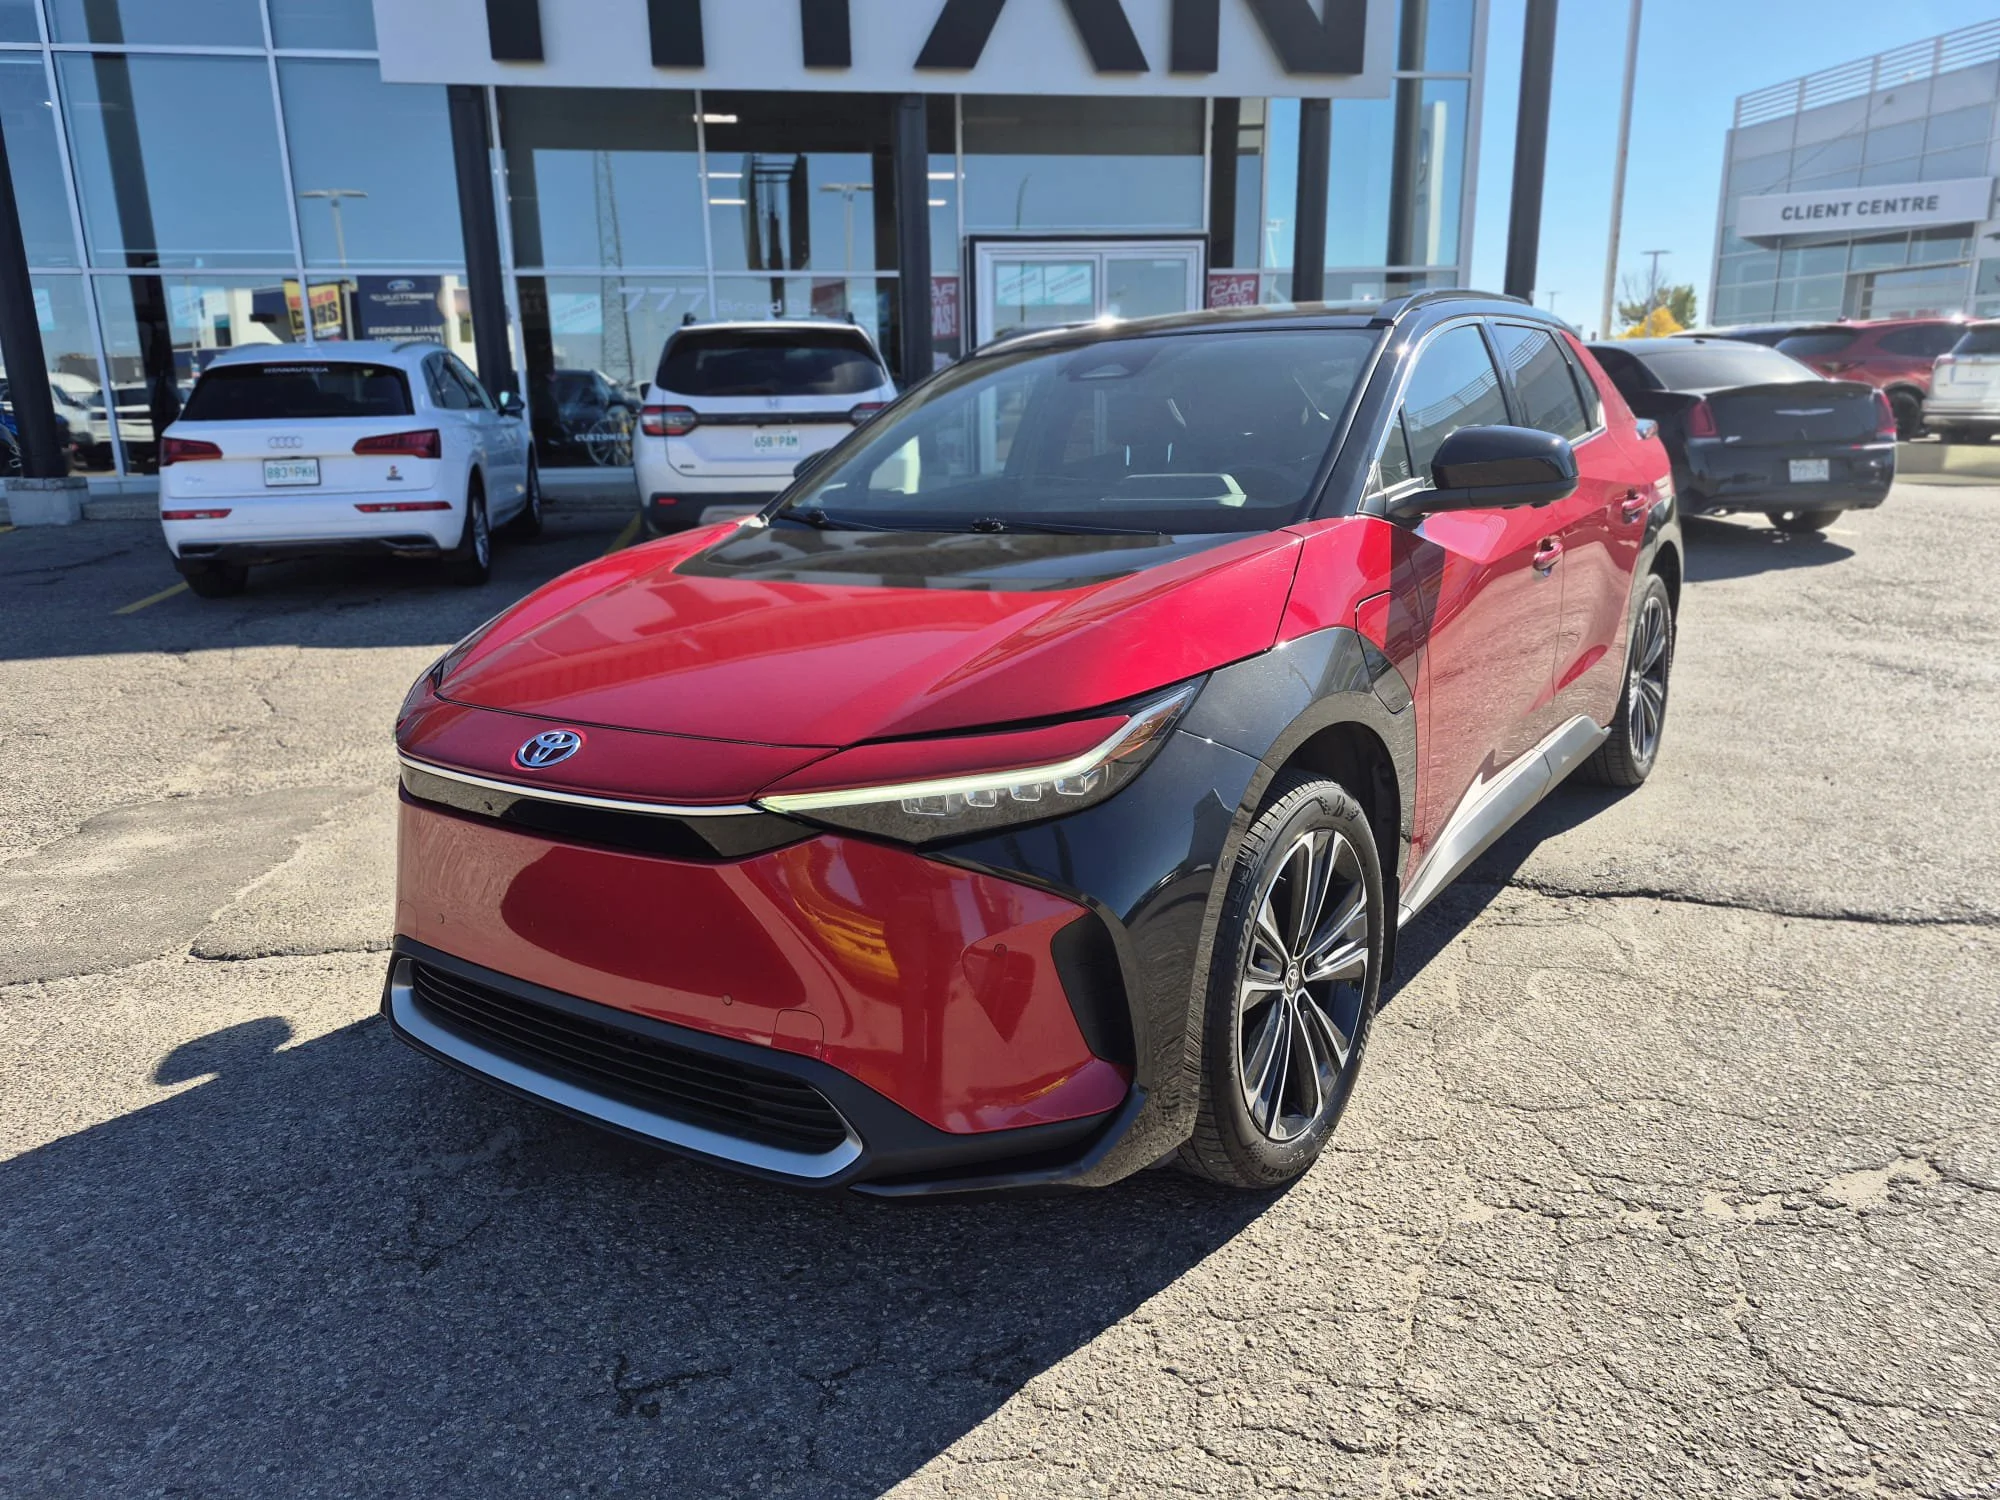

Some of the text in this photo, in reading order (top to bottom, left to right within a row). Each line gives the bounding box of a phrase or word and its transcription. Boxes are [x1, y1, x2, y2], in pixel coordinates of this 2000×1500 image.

[1781, 195, 1940, 221] CLIENT CENTRE
[618, 286, 708, 312] 777
[719, 299, 781, 314] Broad
[1211, 280, 1256, 298] CAR
[291, 301, 339, 329] CRS
